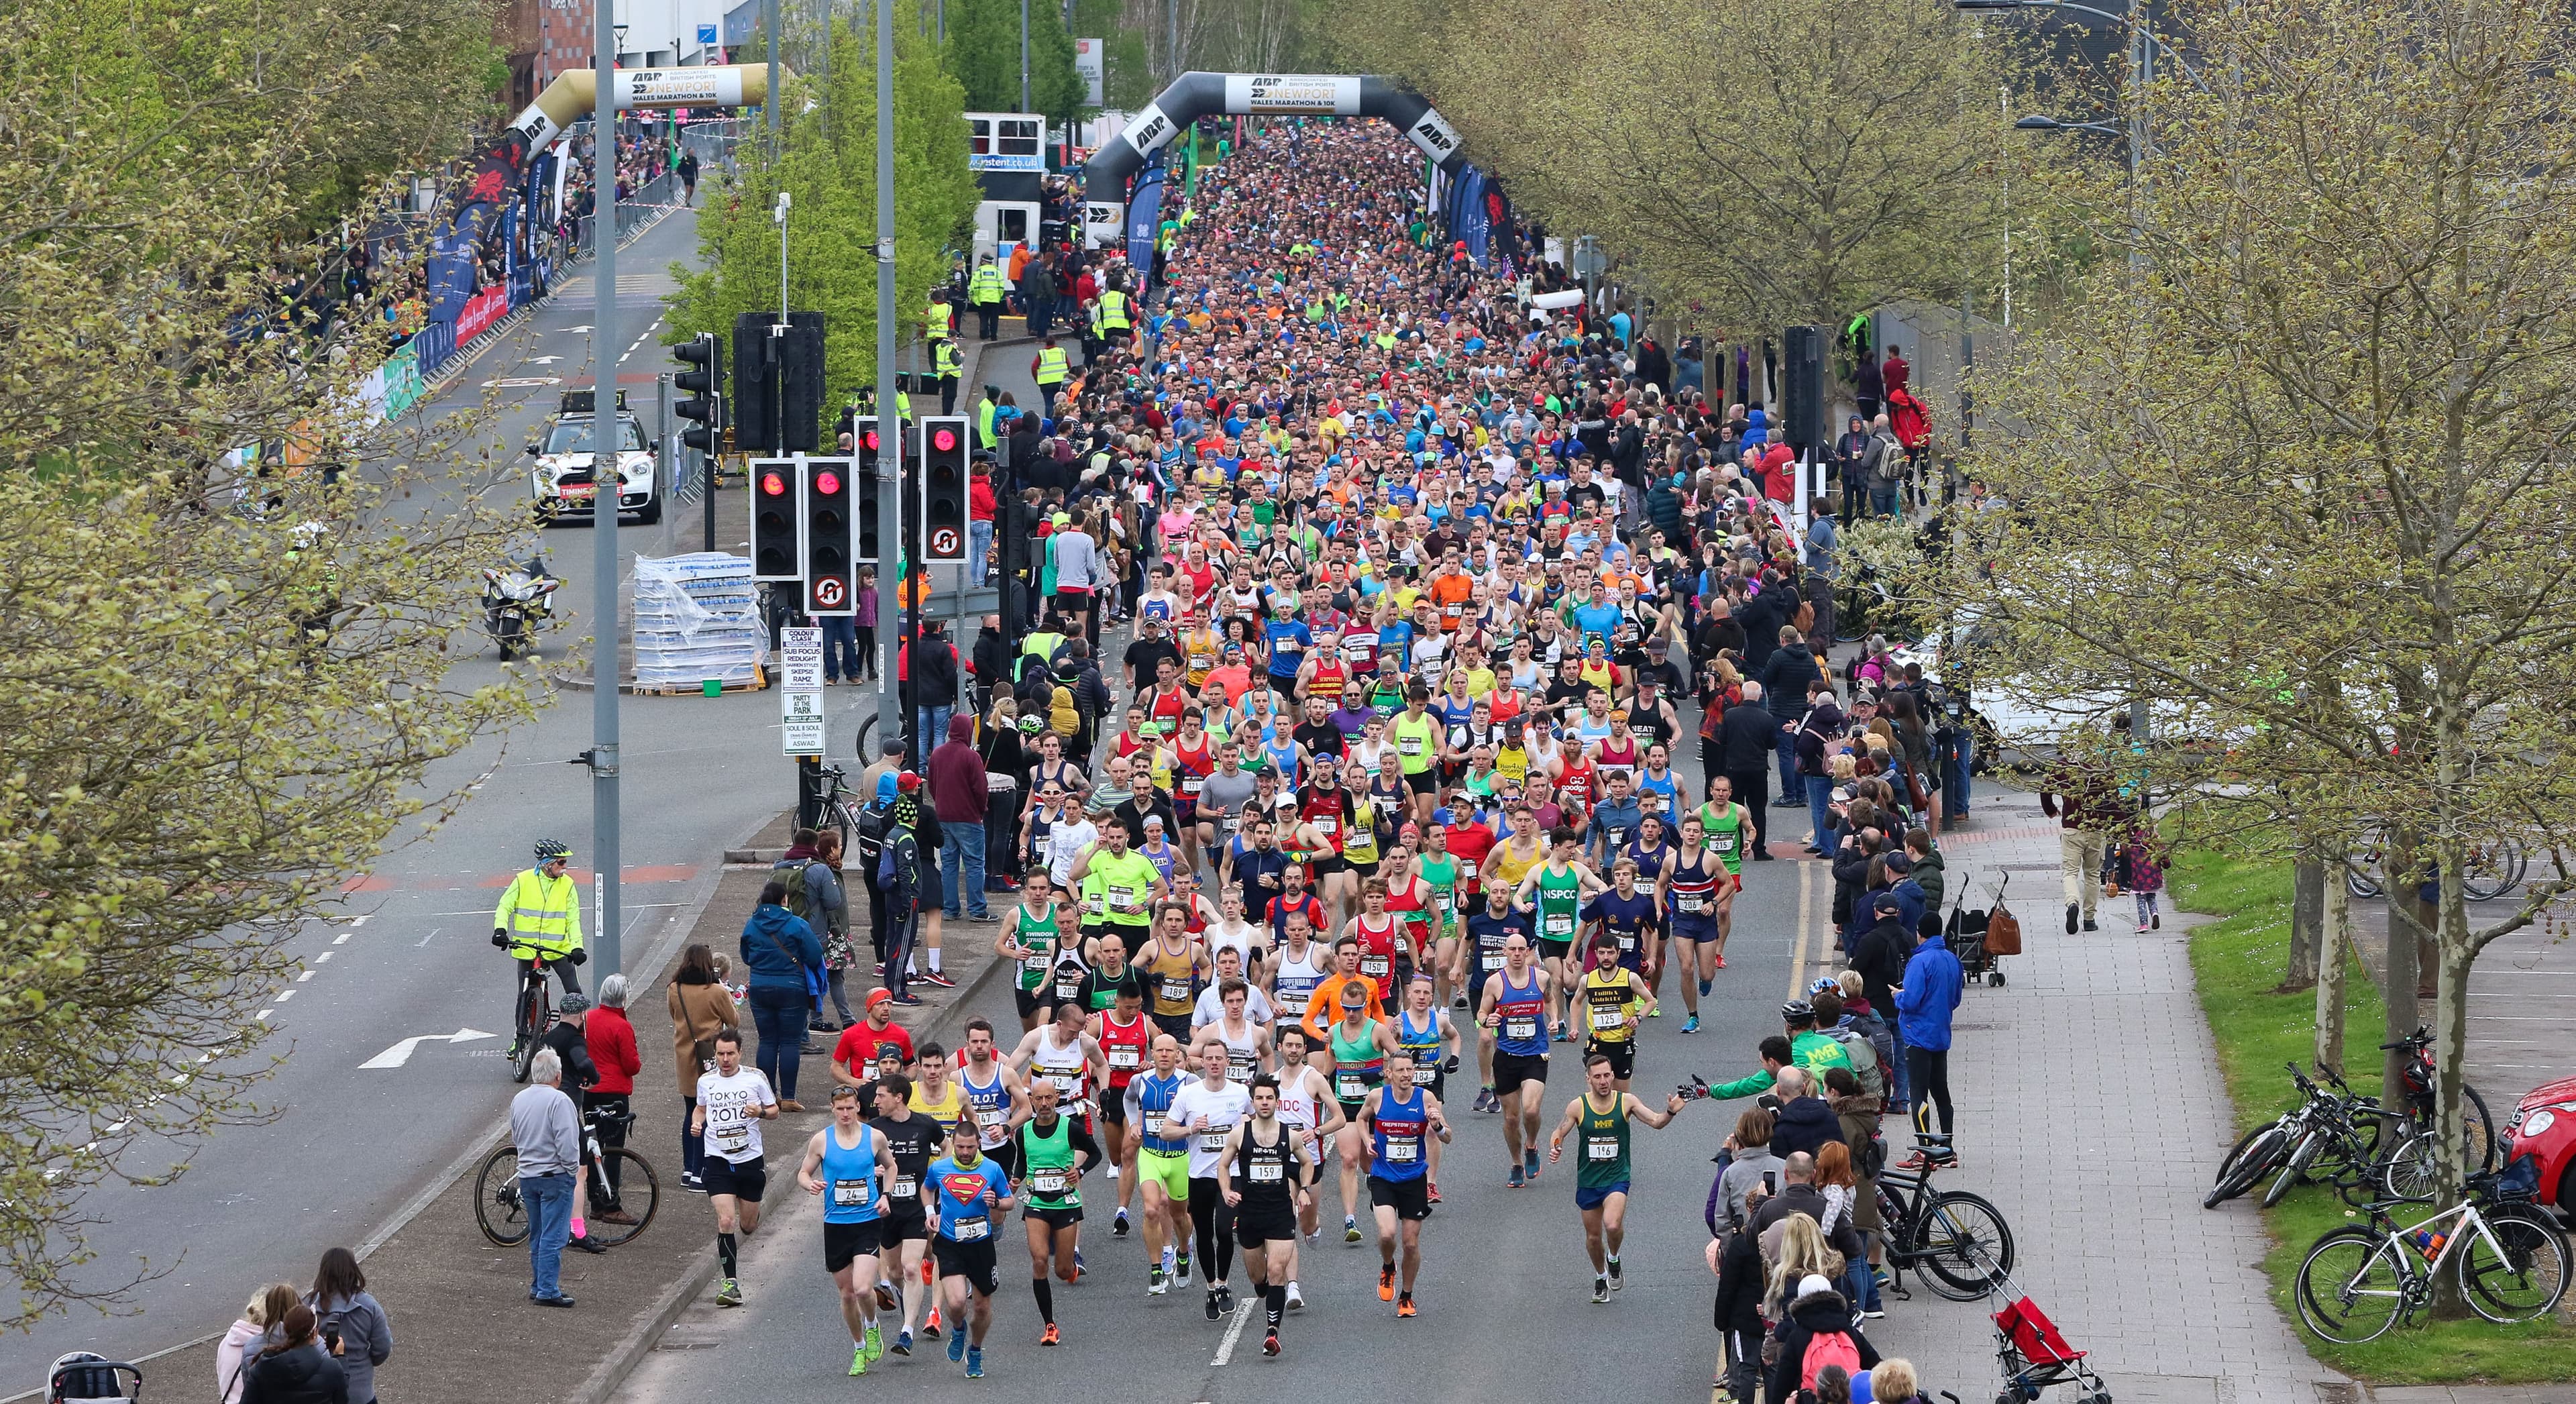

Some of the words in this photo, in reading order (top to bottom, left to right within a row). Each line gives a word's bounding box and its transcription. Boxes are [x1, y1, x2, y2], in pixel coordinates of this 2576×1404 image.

[632, 72, 662, 81] ABP
[656, 81, 716, 93] NEWPORT
[1251, 78, 1282, 87] ABP
[1275, 89, 1335, 99] NEWPORT
[525, 116, 545, 140] BP
[1136, 116, 1165, 150] ABP
[1417, 123, 1452, 150] ABP
[1319, 822, 1330, 830] 198
[1715, 841, 1727, 849] 215
[1544, 889, 1576, 900] NSPCC
[1116, 896, 1124, 904] 88
[1556, 921, 1563, 930] 14
[1032, 957, 1046, 966] 202
[1491, 958, 1501, 967] 73
[1368, 963, 1381, 971] 150
[1063, 987, 1076, 996] 203
[1169, 987, 1182, 996] 189
[1292, 1003, 1297, 1012] 5
[1600, 1014, 1615, 1024] 125
[1516, 1026, 1526, 1035] 22
[1119, 1054, 1129, 1063] 99
[1227, 1068, 1241, 1077] 121
[1415, 1072, 1428, 1081] 183
[1352, 1085, 1356, 1094] 1
[710, 1091, 748, 1101] TOKYO
[712, 1107, 747, 1122] 2016
[729, 1138, 739, 1147] 16
[1209, 1136, 1224, 1145] 151
[1397, 1147, 1407, 1156] 32
[1258, 1167, 1275, 1177] 159
[1042, 1179, 1057, 1188] 145
[892, 1184, 908, 1195] 213
[846, 1190, 857, 1199] 24
[967, 1226, 977, 1236] 35
